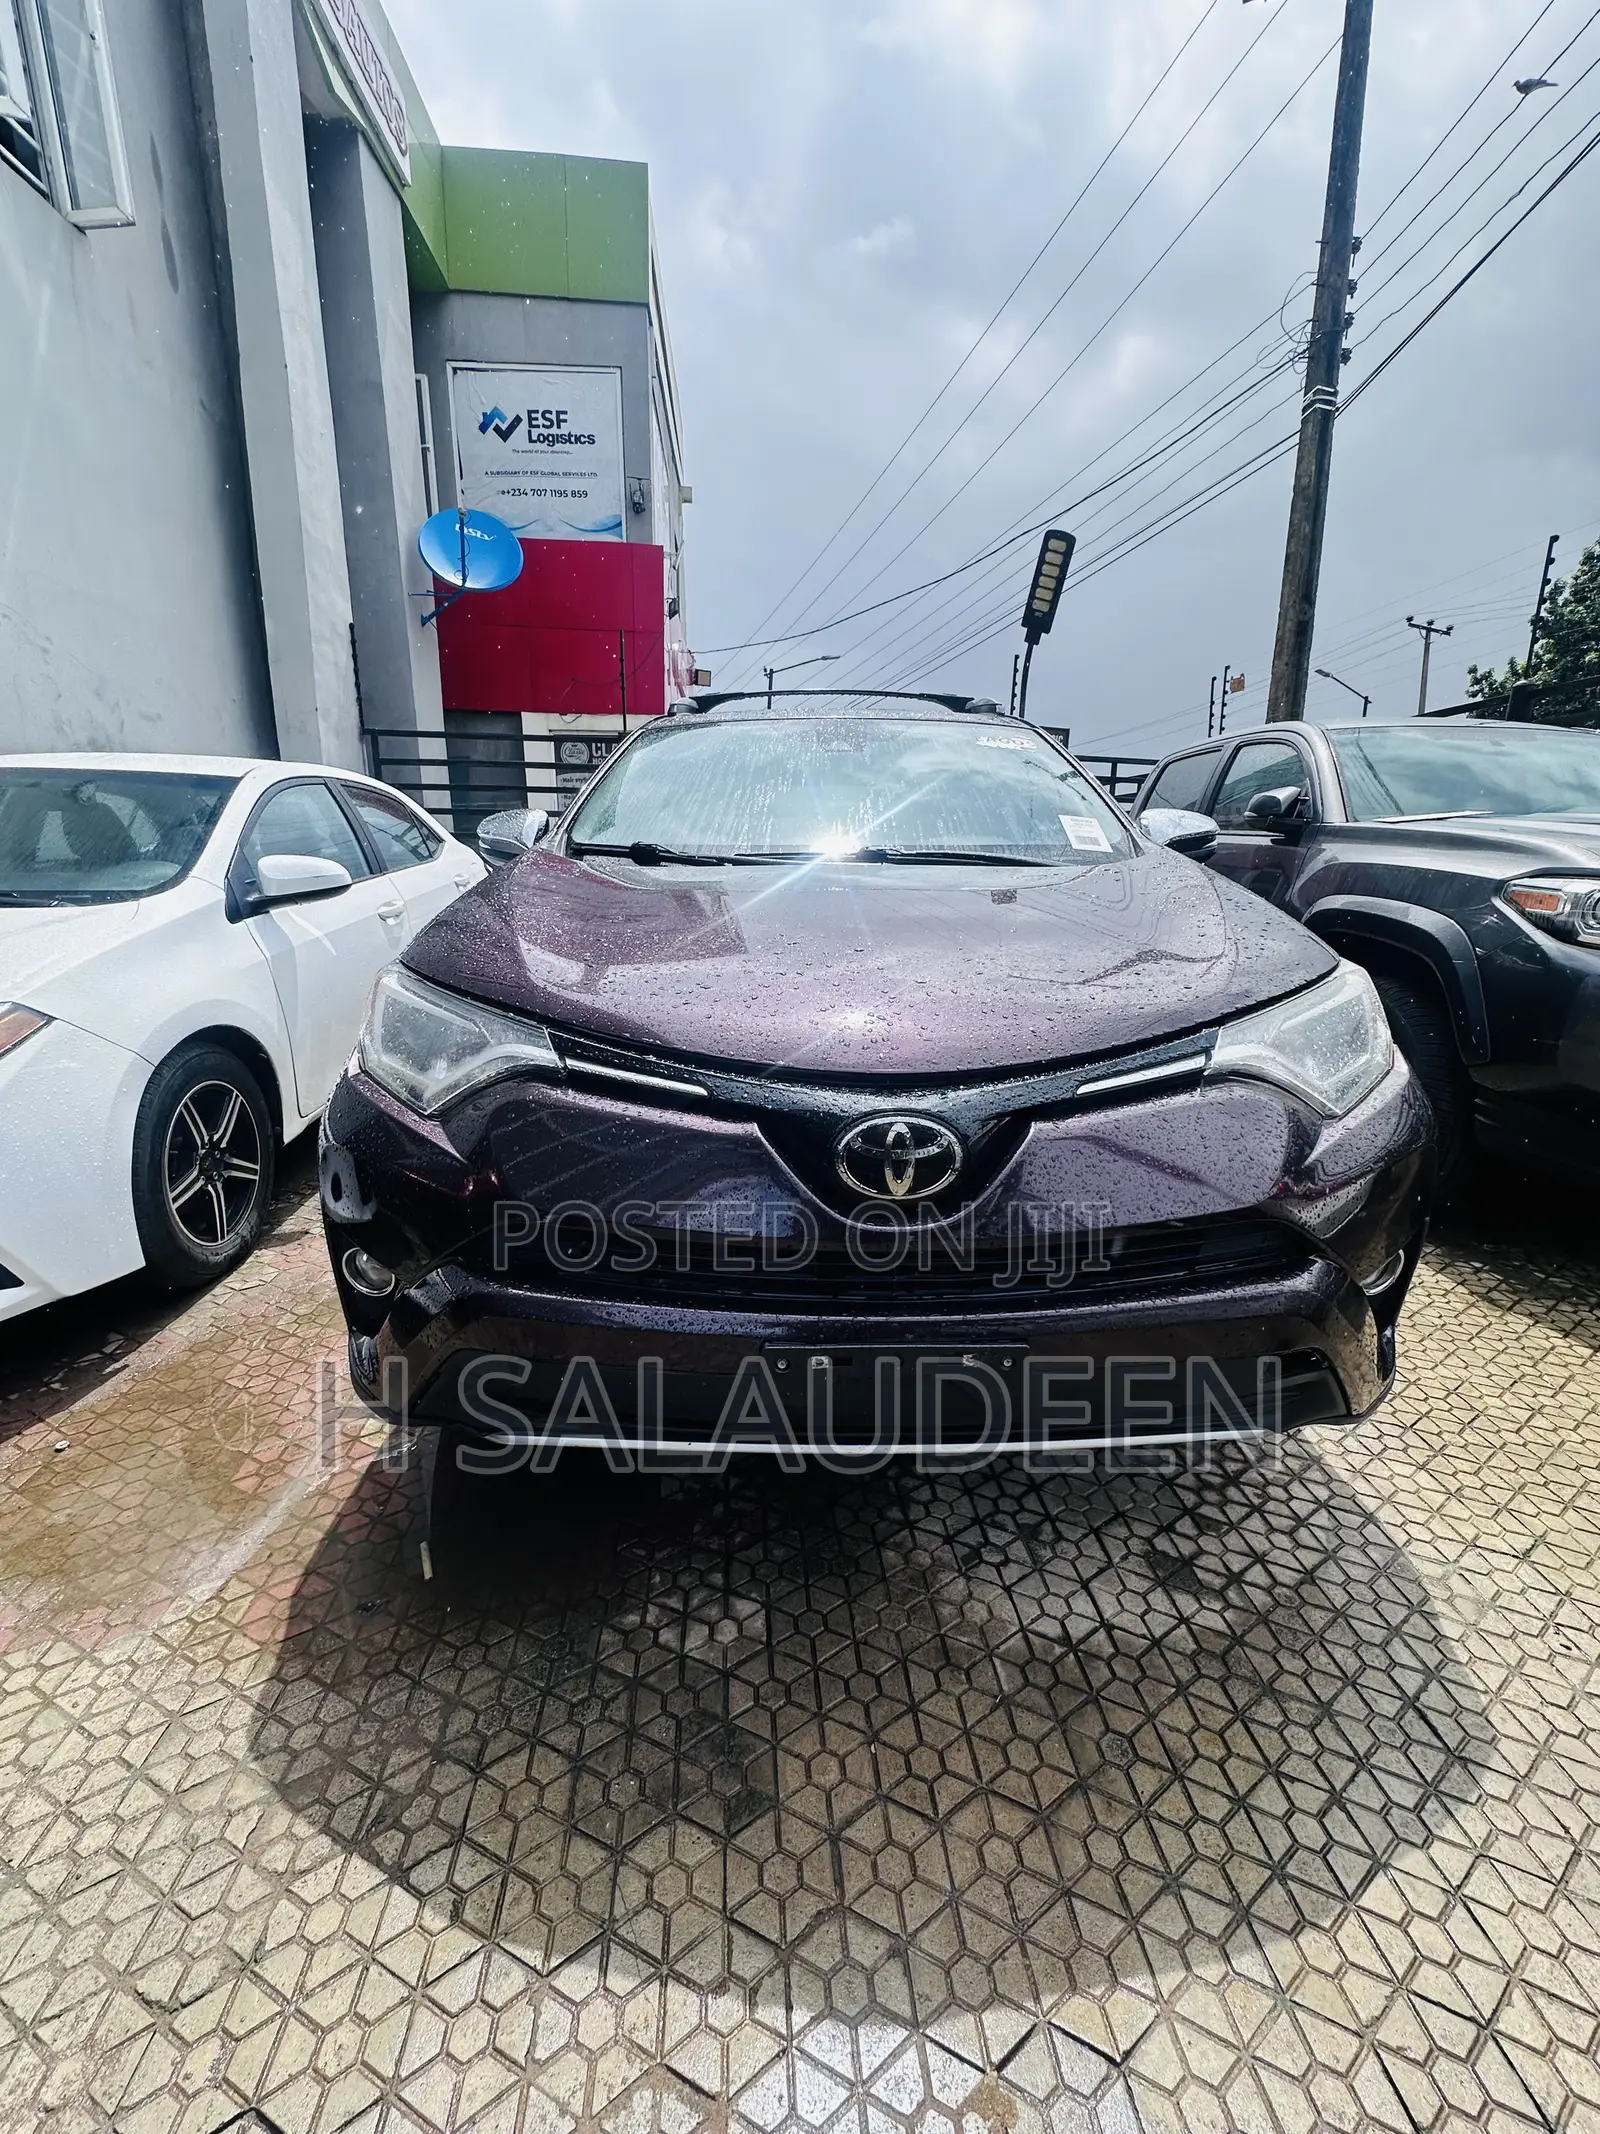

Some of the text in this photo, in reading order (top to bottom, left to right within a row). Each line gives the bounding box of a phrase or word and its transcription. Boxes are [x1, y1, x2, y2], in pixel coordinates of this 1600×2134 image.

[526, 409, 568, 429] ESF
[528, 430, 596, 447] Logistics
[530, 489, 548, 497] 707
[549, 489, 568, 498] 1195
[571, 489, 588, 499] 859
